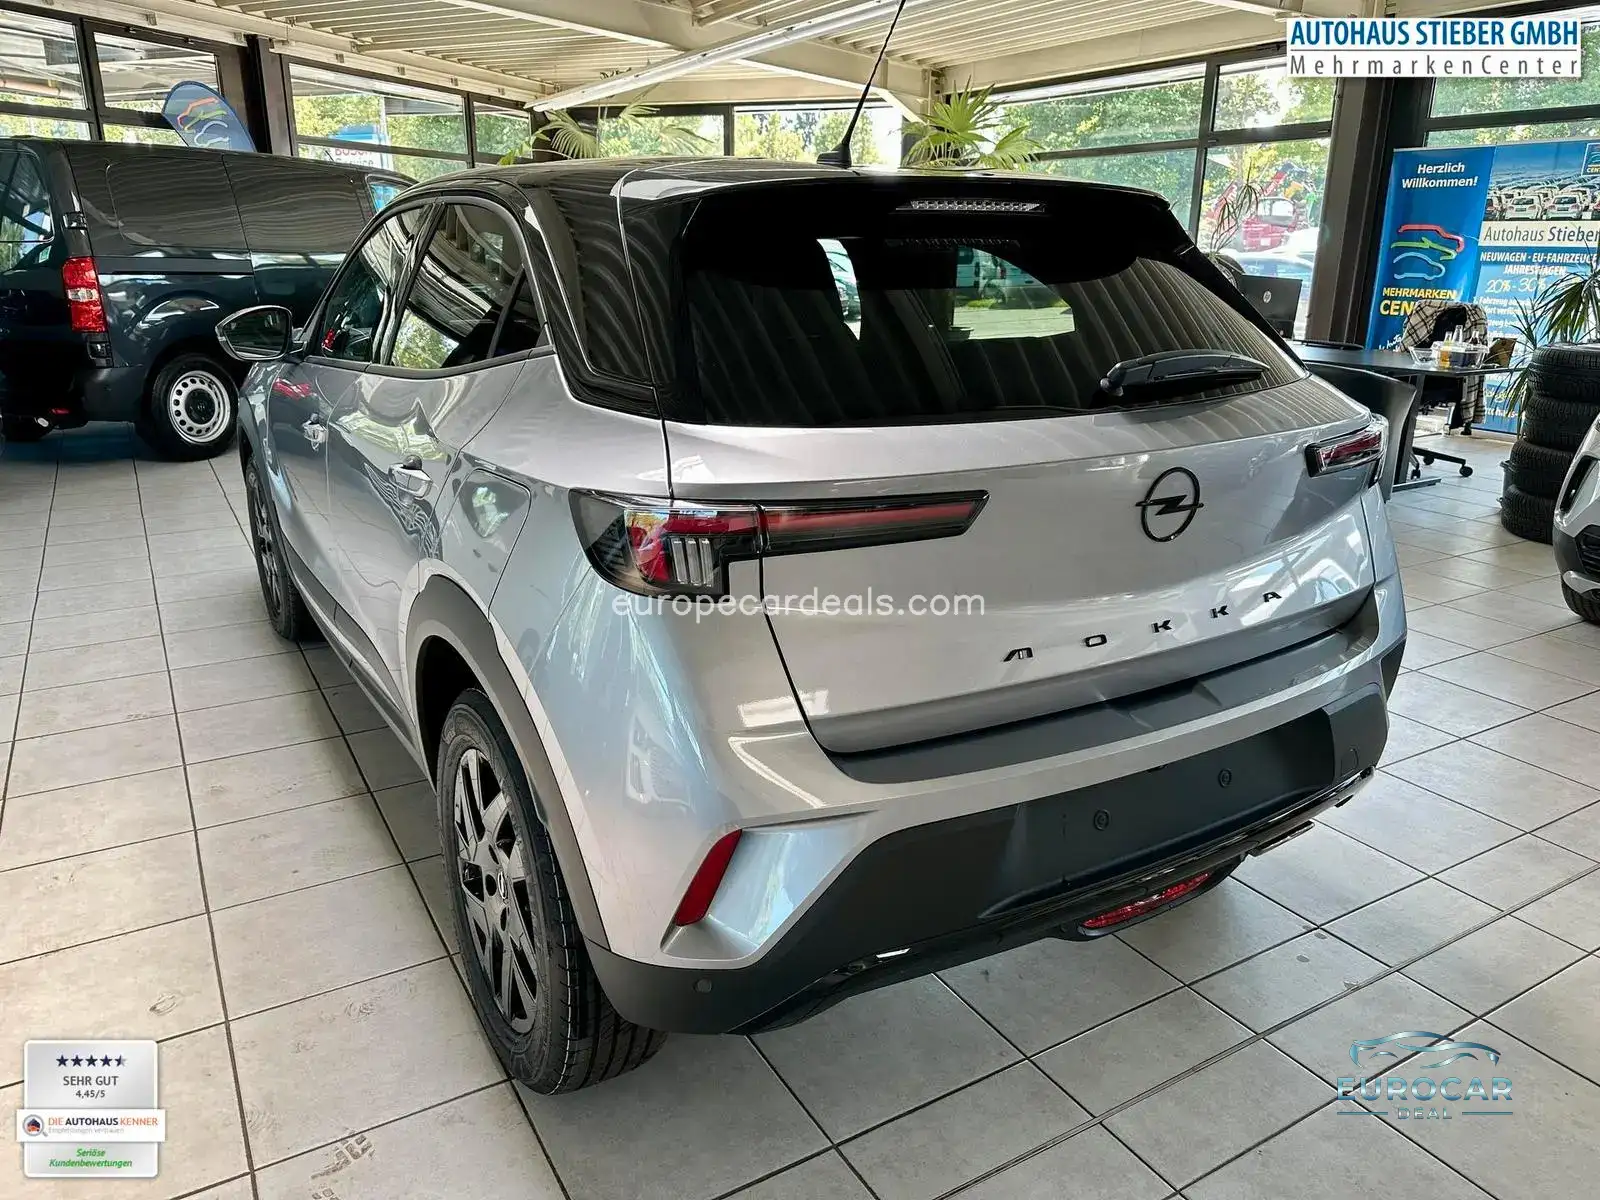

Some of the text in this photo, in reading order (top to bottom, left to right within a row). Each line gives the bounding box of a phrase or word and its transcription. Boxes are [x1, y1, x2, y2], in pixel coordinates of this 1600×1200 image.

[1417, 162, 1465, 174] Herzlich
[1401, 176, 1478, 189] Willkommen!
[1484, 226, 1599, 242] Autohaus Stieber
[1480, 252, 1527, 262] NEUWAGEN
[1503, 264, 1567, 275] JAHRESWAGEN
[1382, 287, 1458, 299] MEHRMARKEN
[1380, 299, 1416, 316] CEN
[1003, 591, 1282, 662] MOKKA
